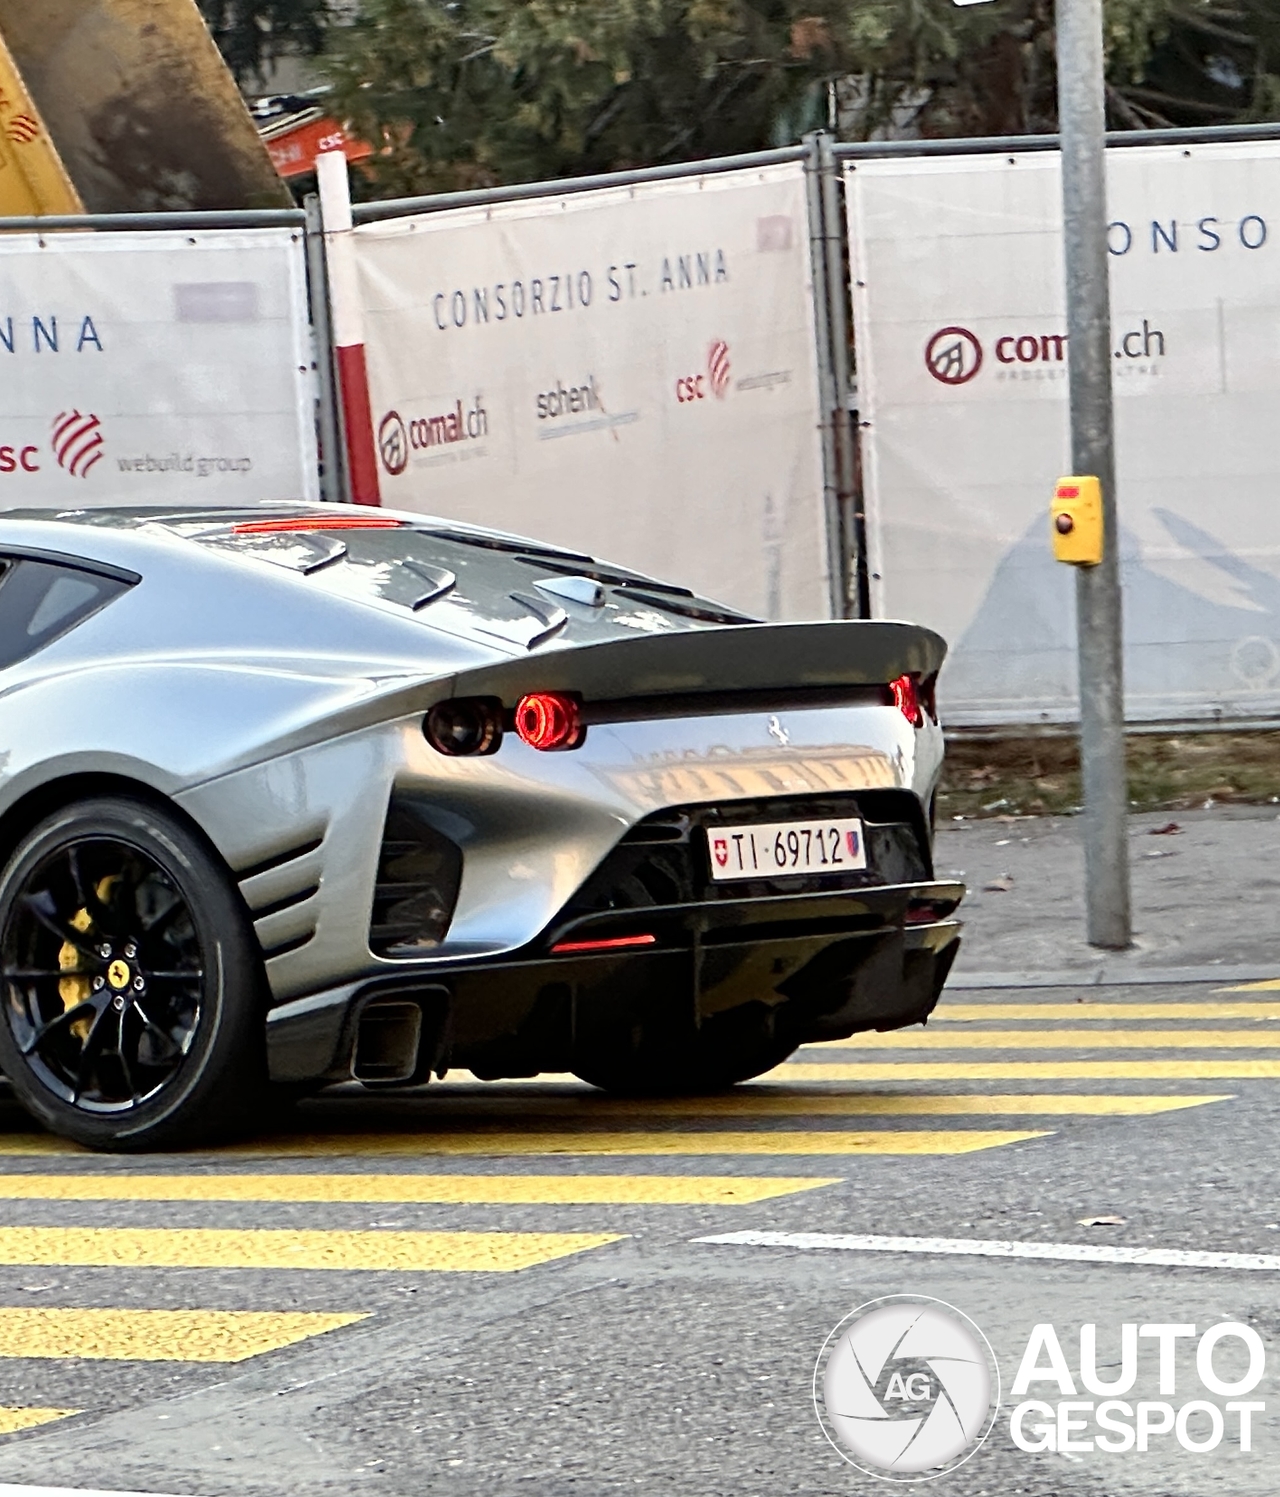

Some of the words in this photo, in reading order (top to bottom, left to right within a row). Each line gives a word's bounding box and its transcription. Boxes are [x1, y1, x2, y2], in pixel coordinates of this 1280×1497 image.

[1107, 215, 1267, 256] ONSO
[433, 270, 592, 330] CONSORZIO
[607, 263, 648, 302] ST.
[660, 248, 729, 293] ANNA
[995, 319, 1166, 364] com.ch
[677, 374, 704, 403] csc
[409, 394, 489, 451] comal.ch
[731, 833, 758, 871] TI
[773, 827, 843, 868] 69712
